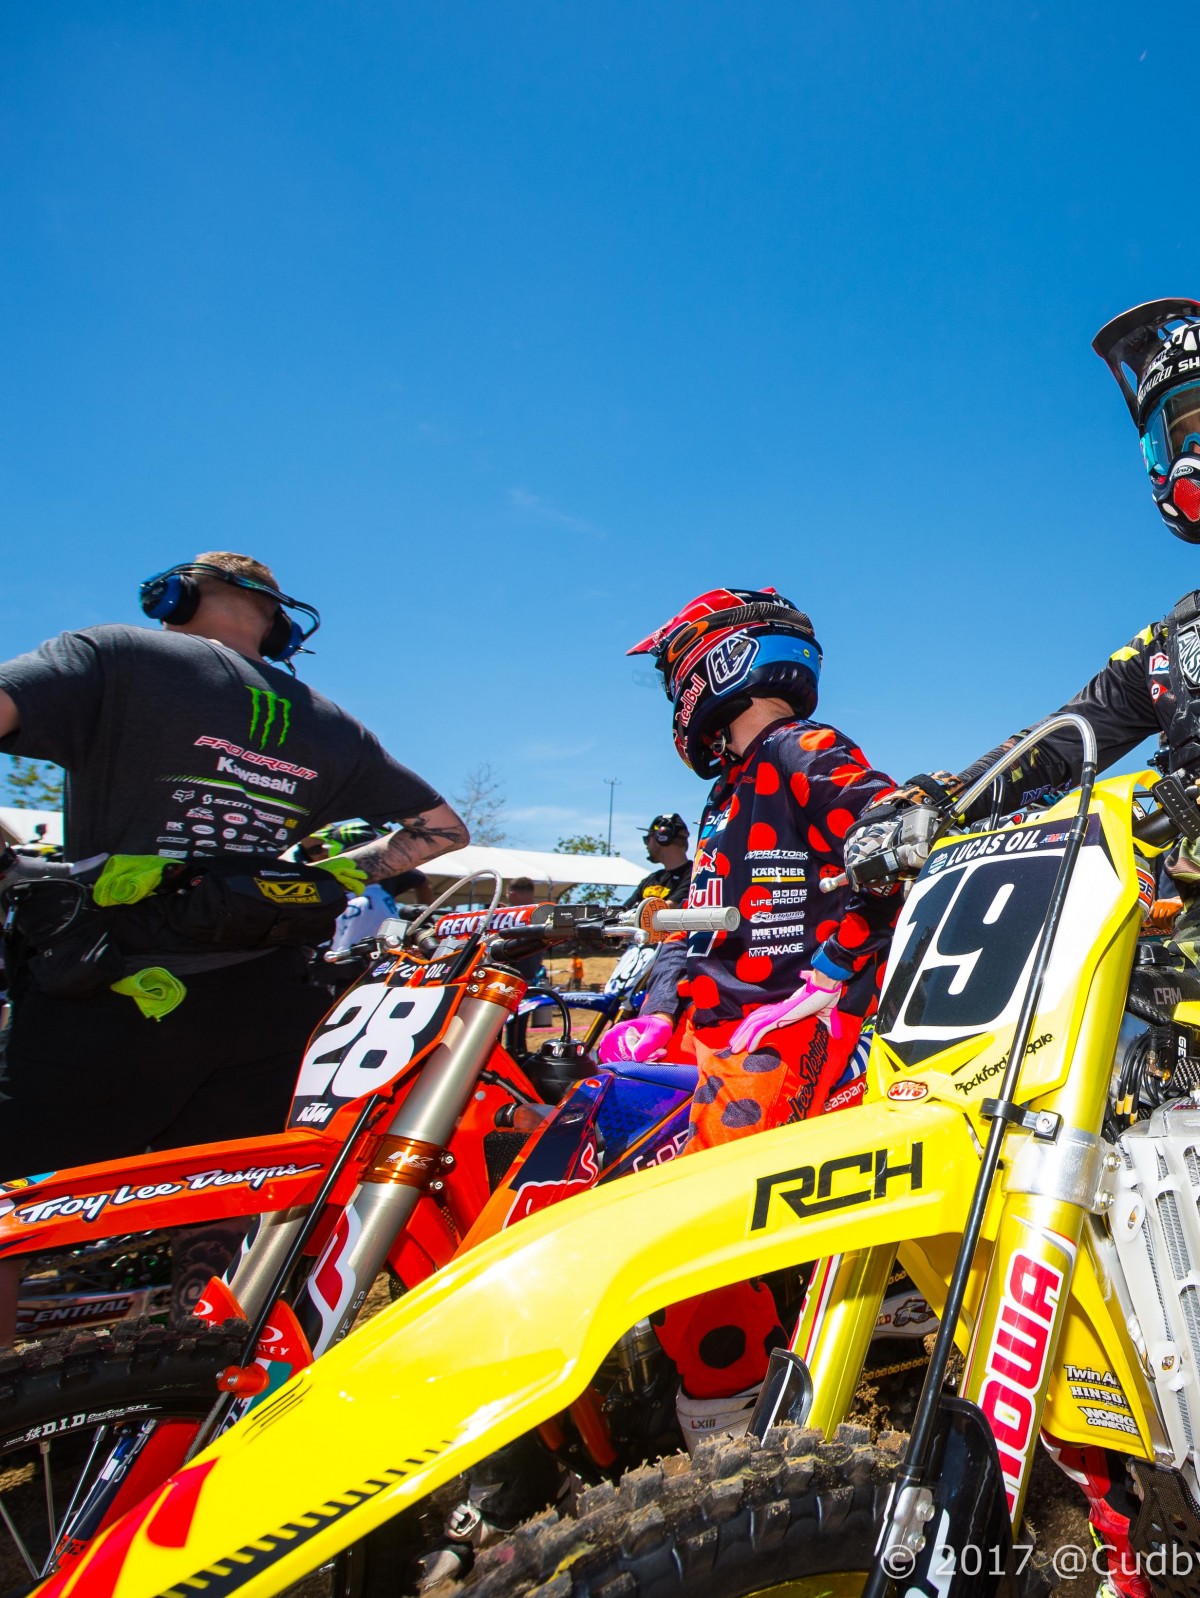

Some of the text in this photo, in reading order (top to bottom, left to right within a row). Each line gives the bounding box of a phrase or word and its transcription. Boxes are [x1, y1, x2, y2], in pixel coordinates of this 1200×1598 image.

[194, 736, 318, 780] PRO CIRCUIT
[217, 757, 297, 795] Kawasaki
[947, 837, 1001, 867] LUCAS
[1008, 830, 1042, 852] OIL
[750, 897, 807, 906] LIFEPROOF
[438, 911, 527, 936] RENTHAL
[752, 925, 804, 937] METHOD
[876, 856, 1063, 1033] 19
[294, 982, 446, 1098] 28
[955, 1055, 1008, 1095] Rockford
[297, 1103, 333, 1123] KTM
[19, 1164, 322, 1222] Troy Lee Designs
[750, 1141, 924, 1232] RCH
[1064, 1365, 1101, 1382] Twin
[42, 1413, 86, 1436] D.I.D
